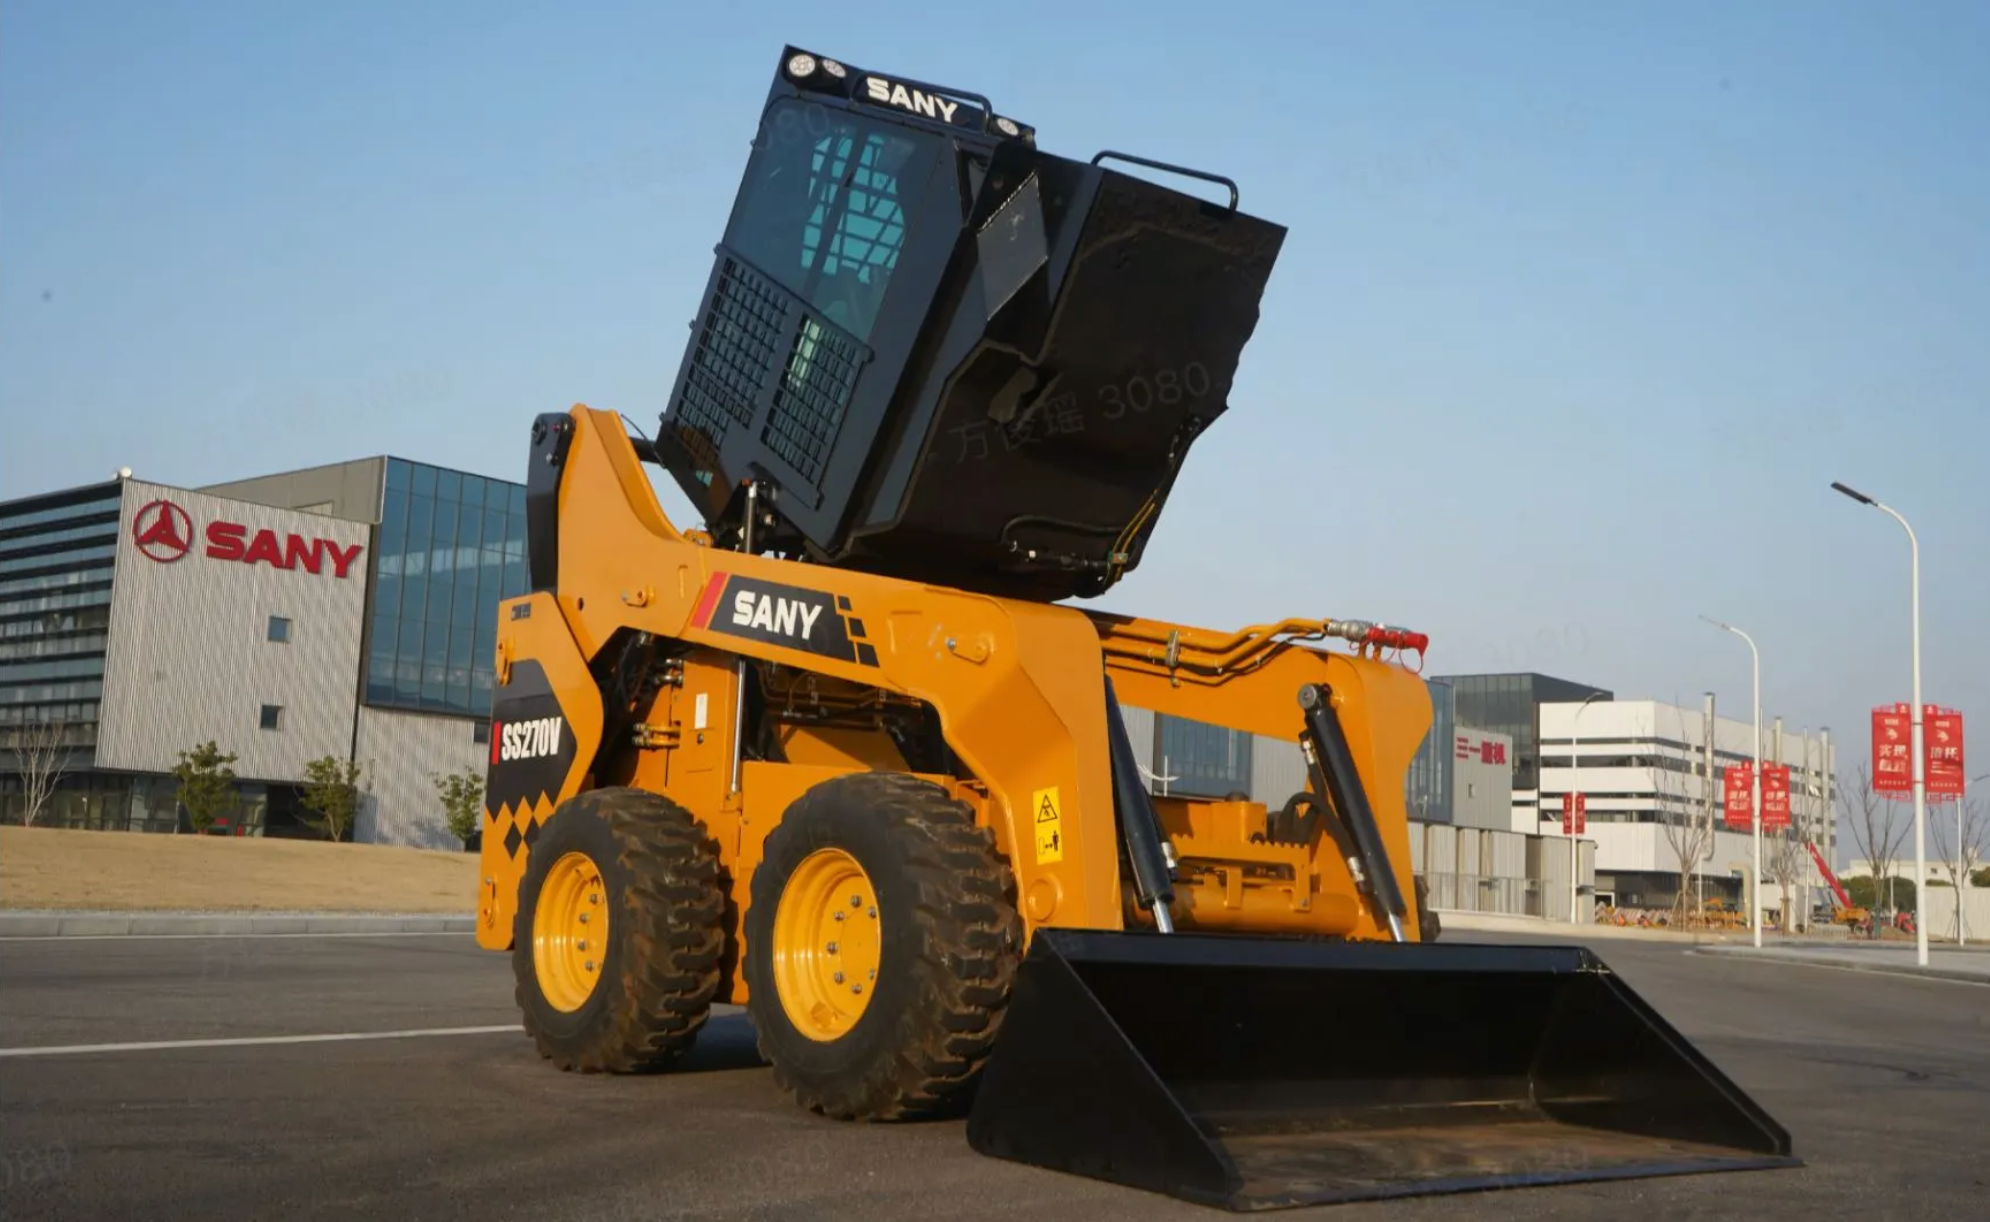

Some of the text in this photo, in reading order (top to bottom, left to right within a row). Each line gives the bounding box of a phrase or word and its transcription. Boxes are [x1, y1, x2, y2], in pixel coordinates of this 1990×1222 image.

[867, 77, 957, 123] SANY
[206, 520, 364, 579] SANY
[732, 590, 823, 640] SANY
[501, 716, 562, 760] SS270V
